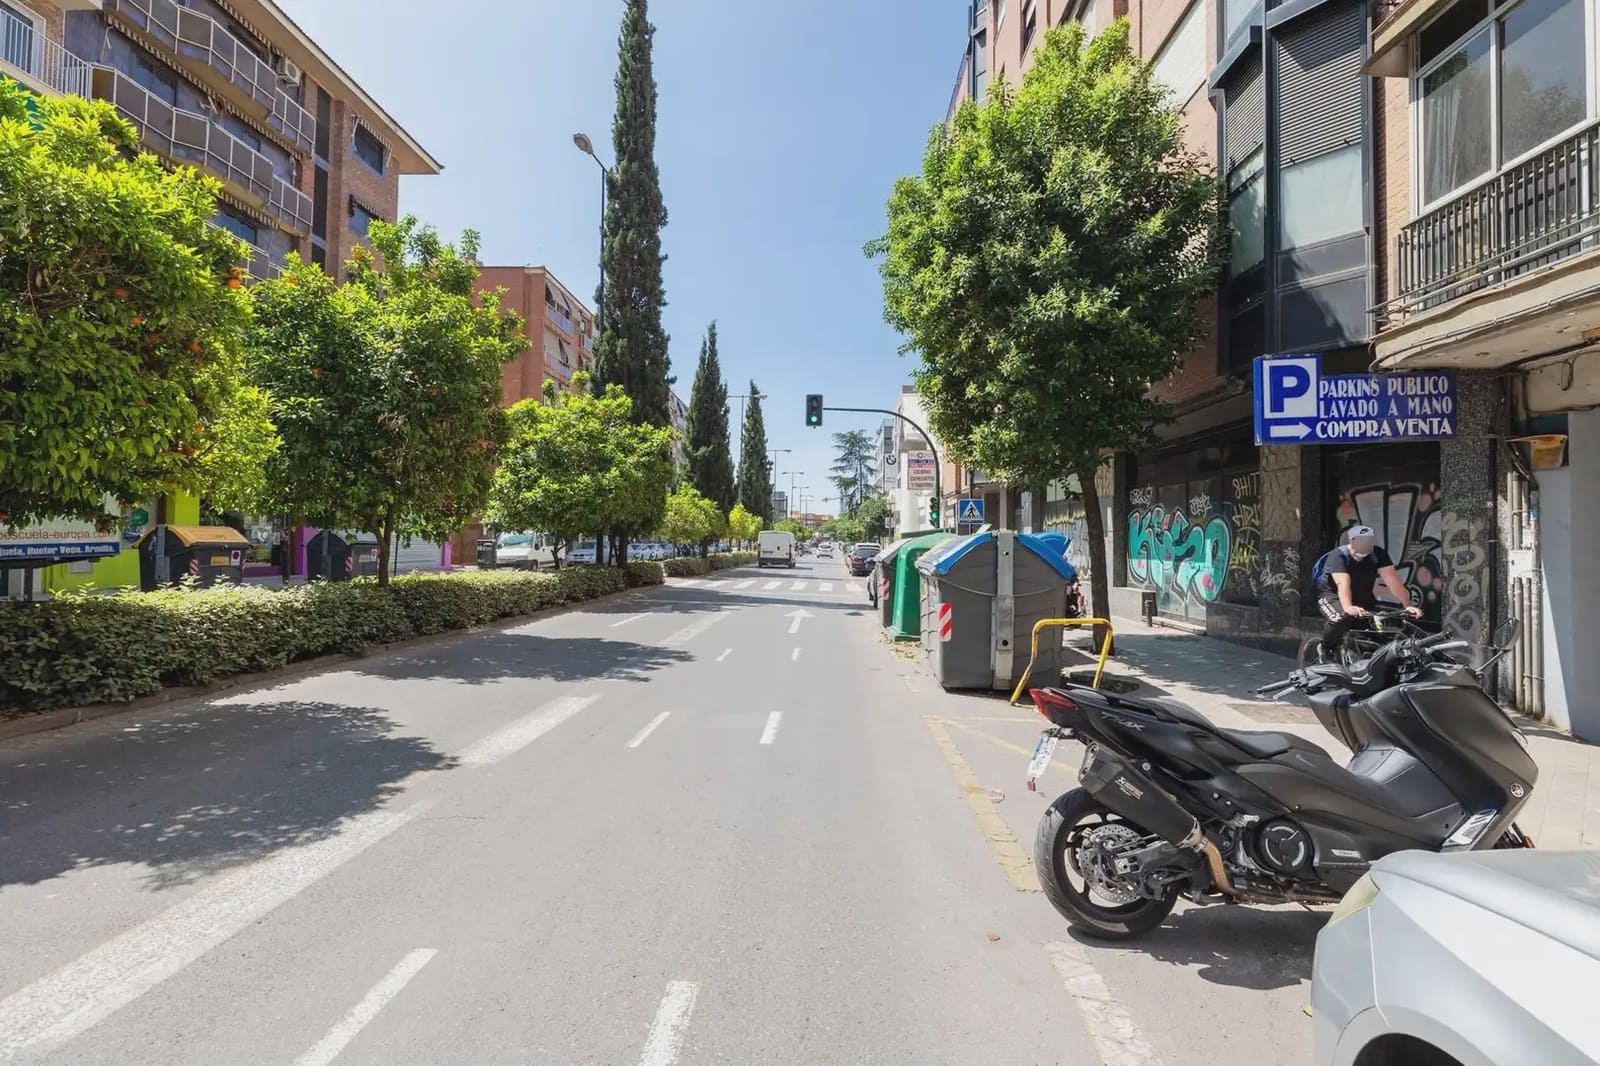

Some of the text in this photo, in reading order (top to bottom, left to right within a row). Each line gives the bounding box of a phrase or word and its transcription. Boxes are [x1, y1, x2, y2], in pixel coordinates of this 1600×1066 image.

[1269, 364, 1311, 413] P
[1387, 376, 1449, 396] PUBLICO
[1319, 396, 1453, 419] LAVADO A MANO
[1315, 417, 1453, 439] COMPRA VENTA
